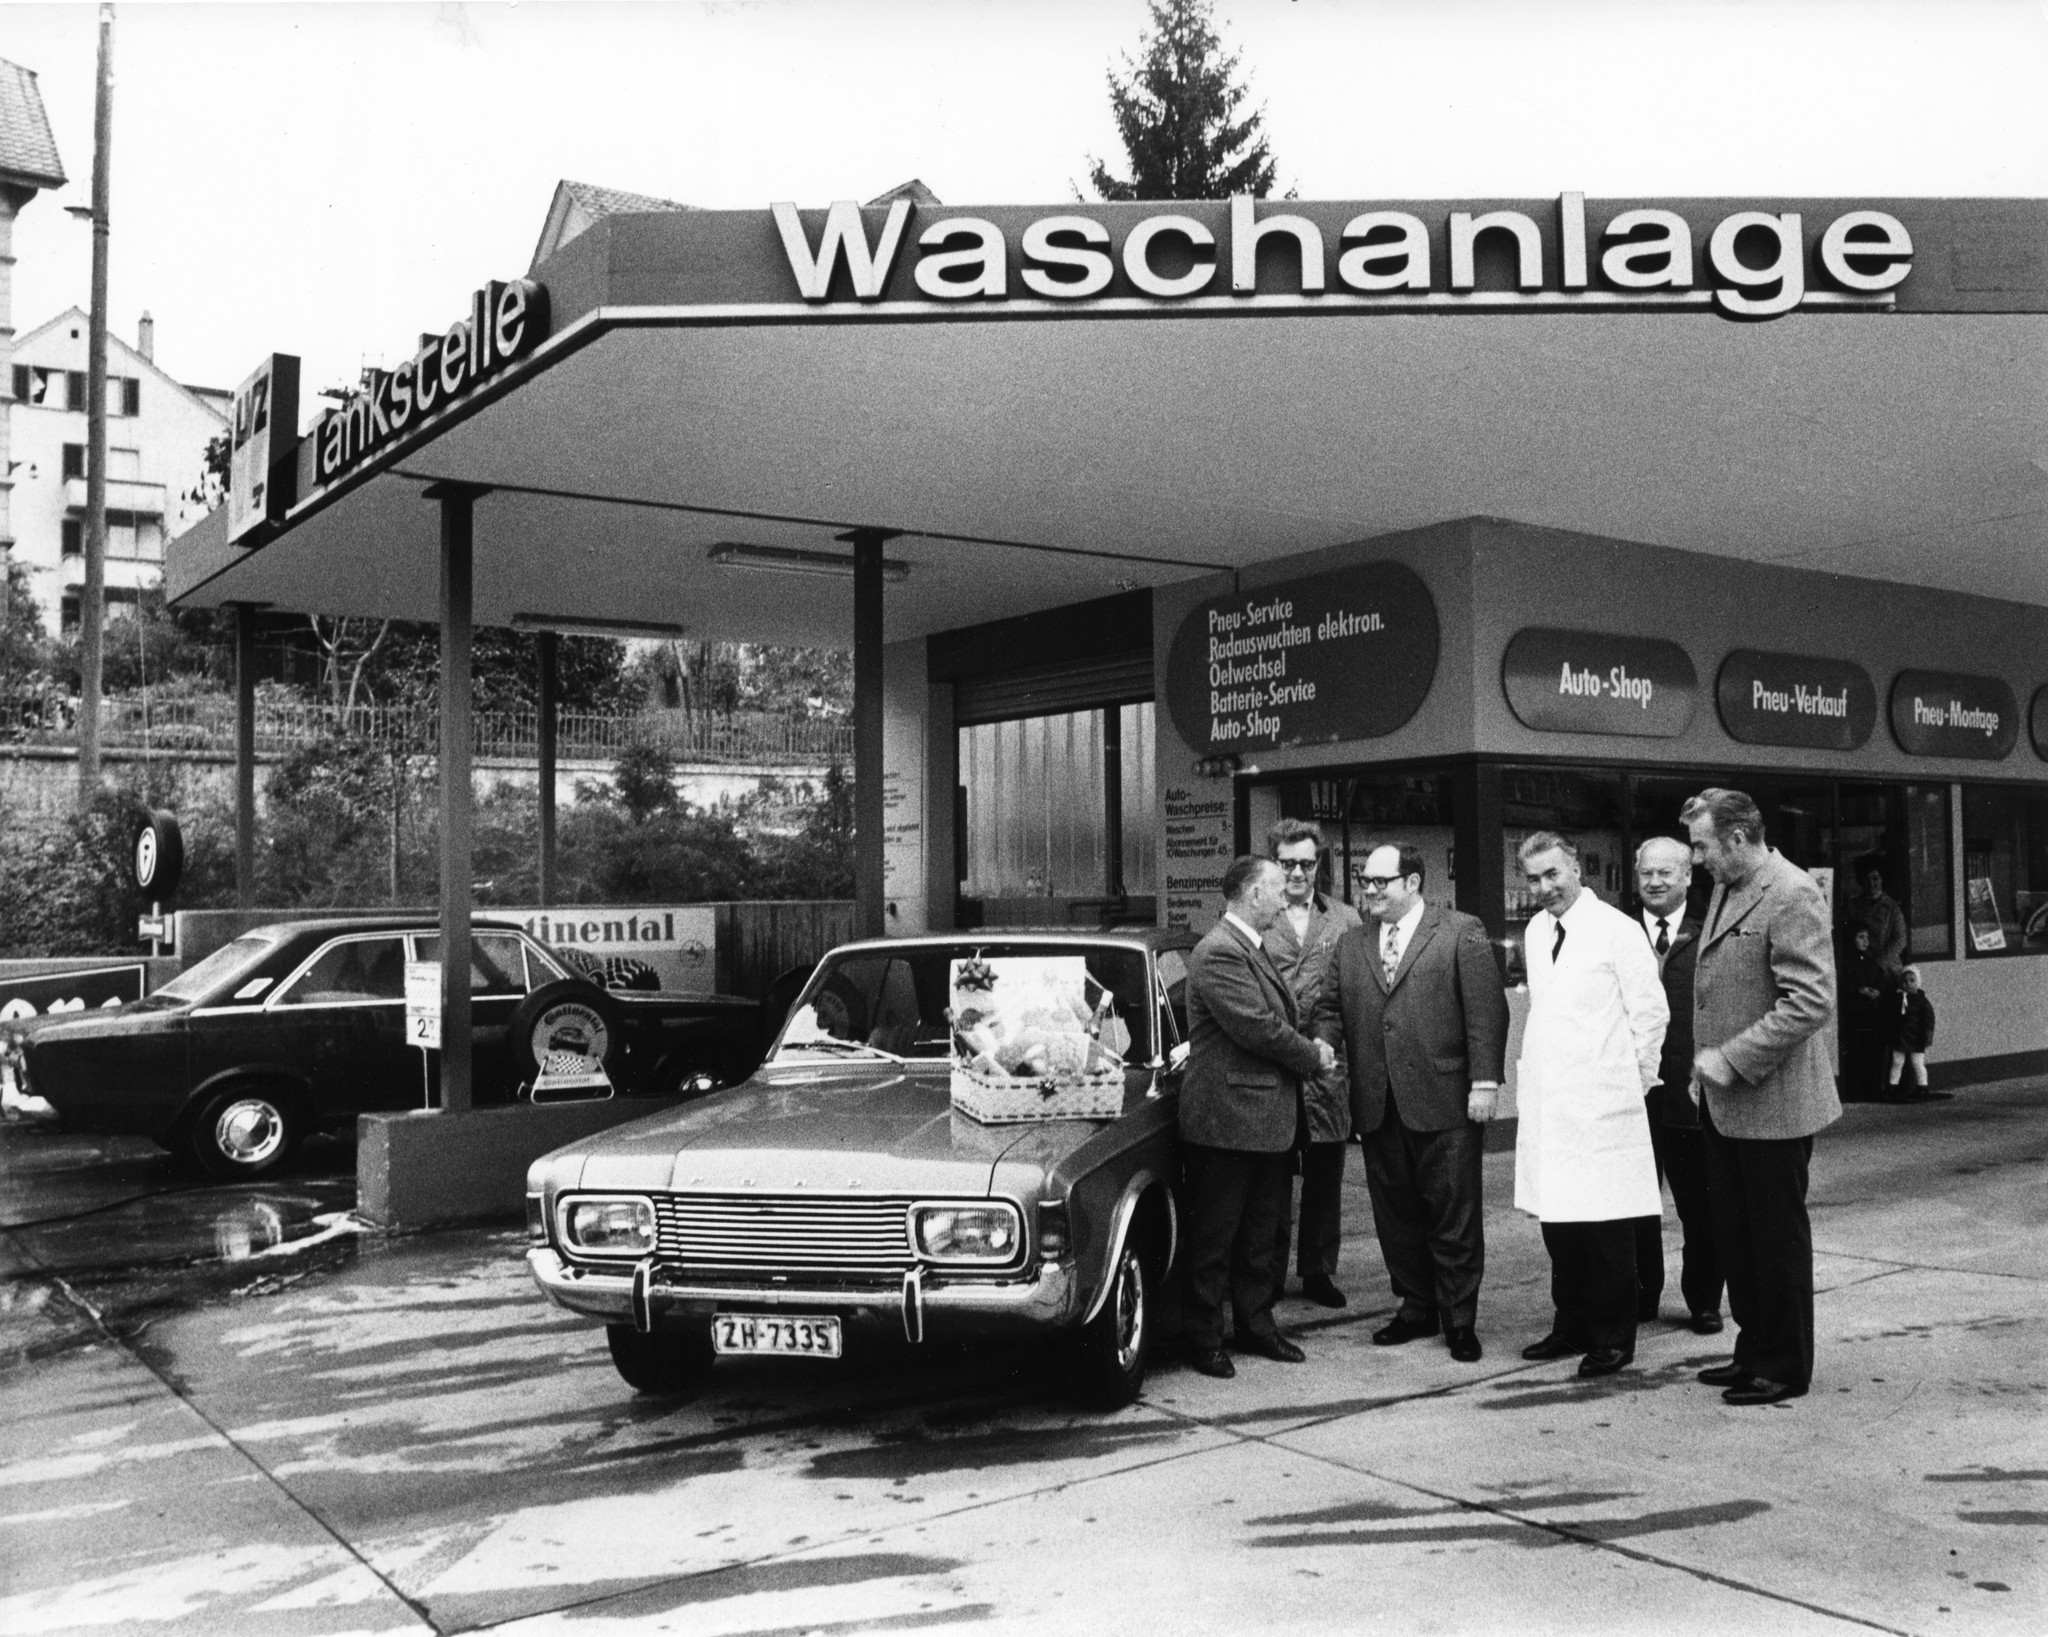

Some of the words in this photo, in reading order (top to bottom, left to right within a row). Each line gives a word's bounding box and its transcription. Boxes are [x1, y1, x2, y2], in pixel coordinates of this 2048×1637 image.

[770, 191, 1914, 315] Waschanlage
[307, 279, 527, 483] Tankstelle
[1208, 597, 1293, 634] Pneu-Service
[1209, 621, 1311, 662] Radauswuchten
[1317, 610, 1385, 640] elektron.
[1210, 650, 1285, 687] Oelwechsel
[1559, 662, 1652, 709] Auto-Shop
[1211, 678, 1316, 715] Batterie-Service
[1753, 680, 1847, 717] Pneu-Verkauf
[1210, 710, 1281, 742] Auto-Shop
[1914, 697, 1999, 737] Pneu-Montage
[1165, 788, 1192, 801] Auto-
